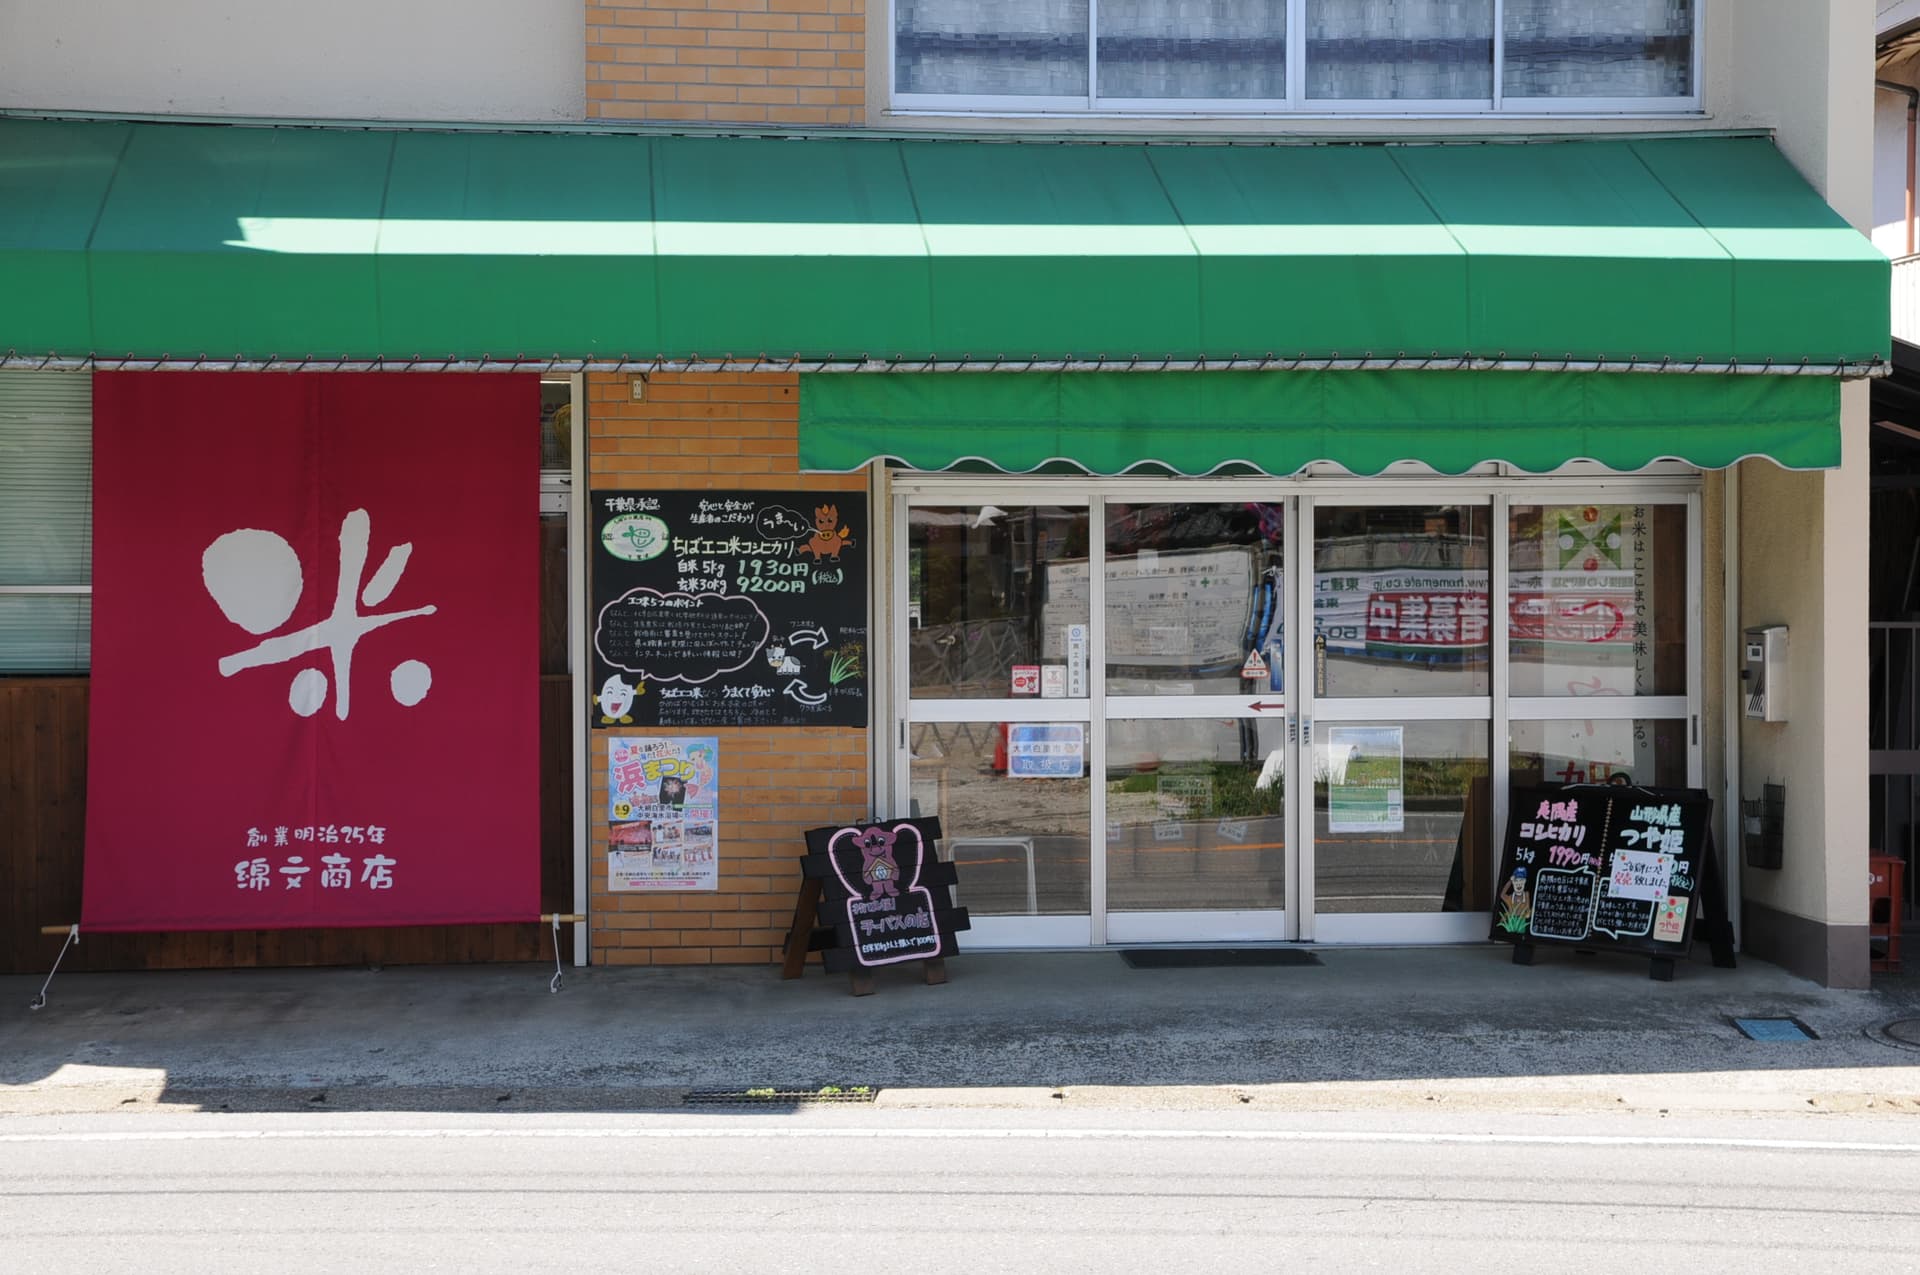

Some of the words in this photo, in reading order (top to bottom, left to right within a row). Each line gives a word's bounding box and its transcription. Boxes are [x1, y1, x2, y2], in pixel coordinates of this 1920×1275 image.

[699, 499, 754, 512] 安心と安全が
[690, 513, 754, 525] 生産者のこだわり
[672, 535, 795, 559] ちばエコ米コシヒカリ
[678, 559, 698, 573] 白米
[703, 560, 725, 578] 5kg
[737, 559, 809, 577] 1930円
[812, 568, 844, 585] (税込)
[677, 577, 727, 595] 玄米30kg
[737, 576, 806, 594] 9200円
[202, 508, 437, 721] 米
[1632, 506, 1649, 749] お米はここまで美味しくる。
[721, 684, 775, 699] うまくて安心
[614, 758, 696, 794] 浜まつり
[1629, 803, 1683, 828] 山形県産
[247, 824, 387, 848] 創業明治25年
[1519, 823, 1587, 848] コシヒカリ
[1620, 828, 1685, 854] つや姫
[1515, 848, 1536, 864] 5kg
[1548, 844, 1590, 867] 1990円
[234, 852, 397, 892] 綿文商店
